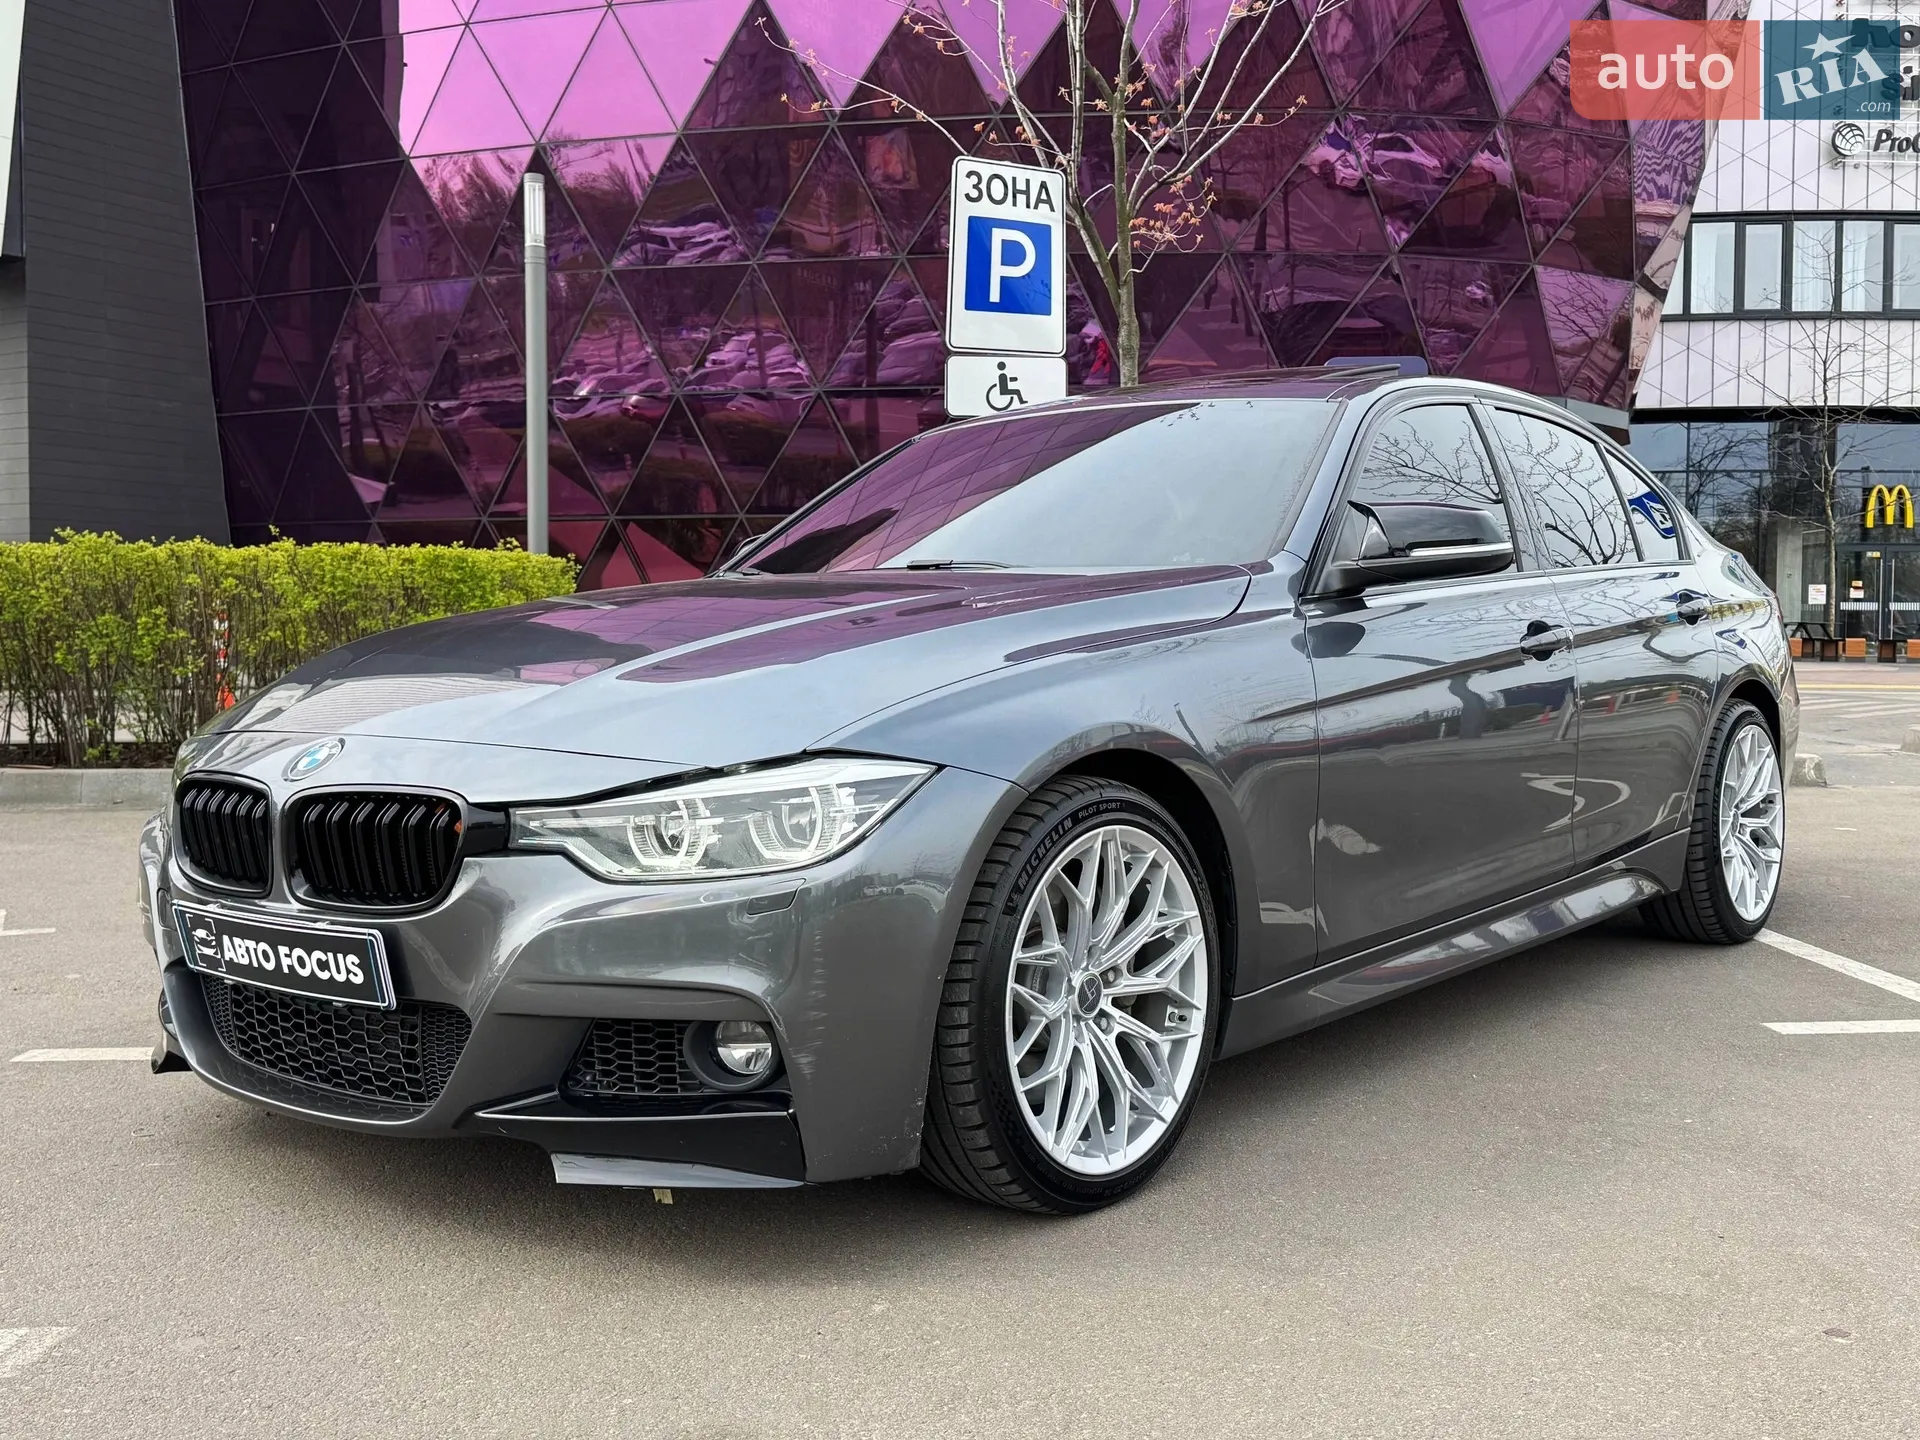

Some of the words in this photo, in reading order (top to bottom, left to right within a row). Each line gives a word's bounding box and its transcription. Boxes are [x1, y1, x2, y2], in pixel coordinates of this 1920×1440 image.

[964, 170, 1055, 213] ЗОНА
[989, 227, 1036, 303] P
[1017, 817, 1073, 891] MICHELIN
[1078, 805, 1098, 819] PILOT
[1099, 802, 1121, 811] SPORT
[277, 945, 364, 985] FOCUS
